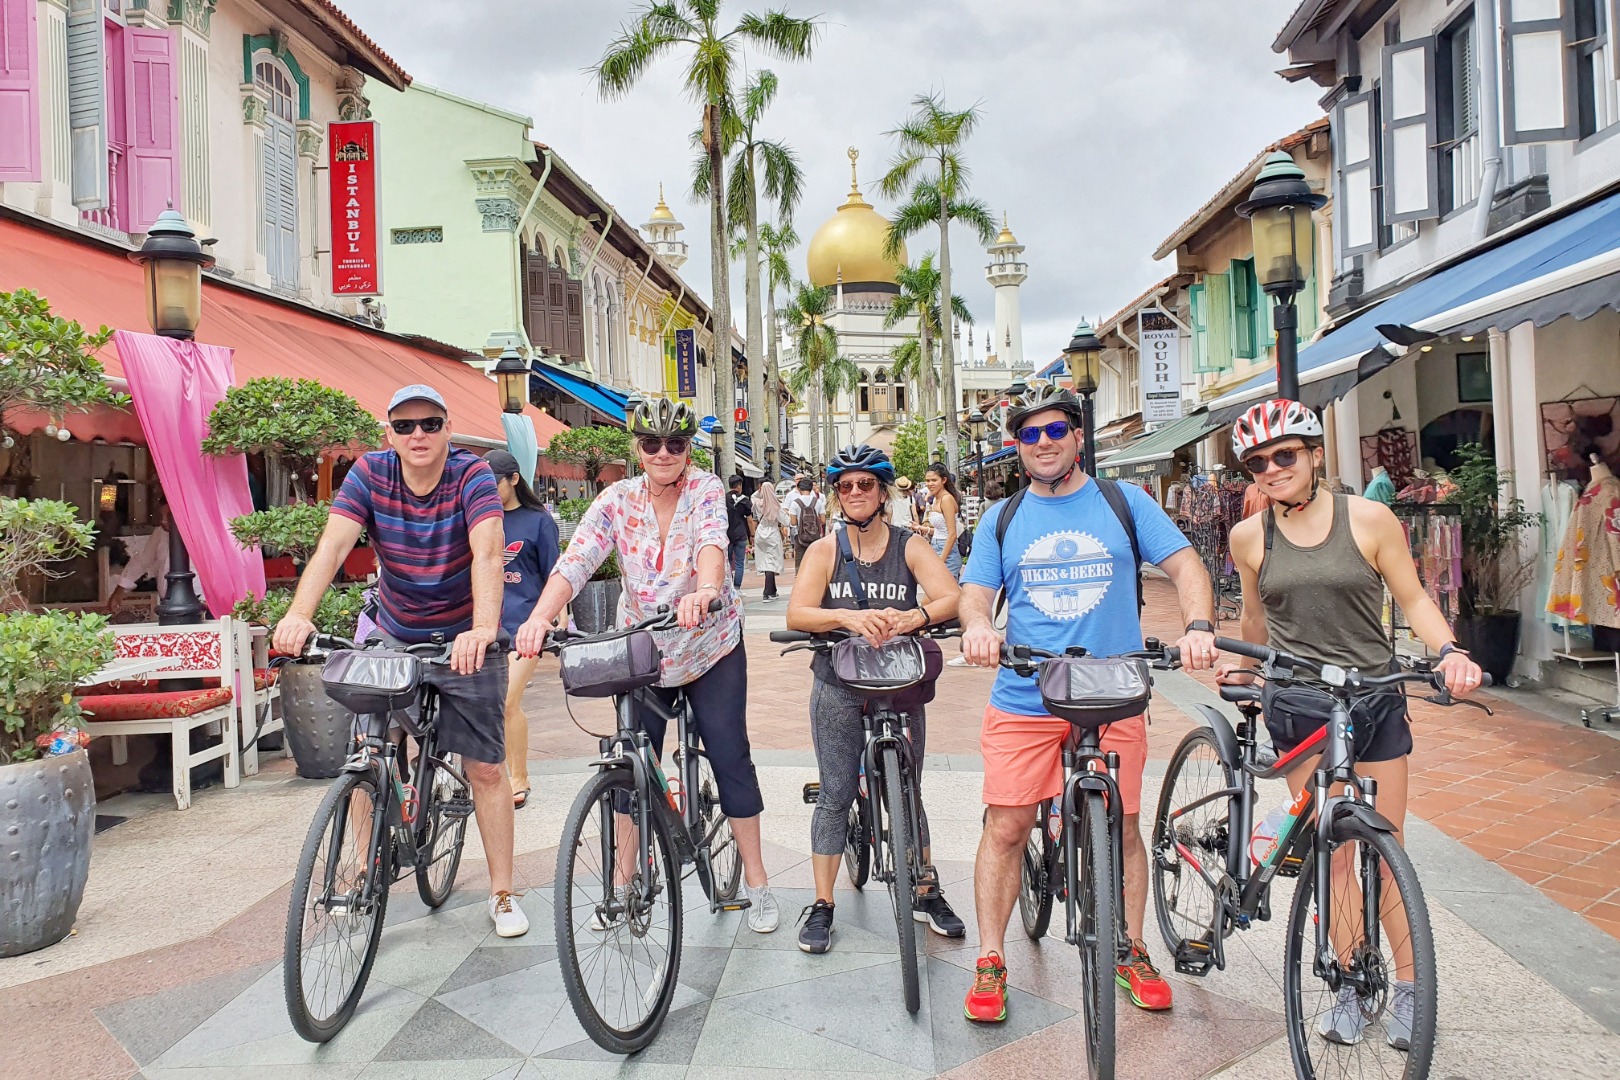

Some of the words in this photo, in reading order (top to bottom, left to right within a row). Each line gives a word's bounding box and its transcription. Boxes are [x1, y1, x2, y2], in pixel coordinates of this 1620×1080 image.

[345, 163, 360, 252] ISTANBUL
[1144, 332, 1177, 340] ROYAL
[682, 343, 690, 391] TURKISH
[1153, 340, 1169, 382] OUDH
[738, 410, 743, 419] i
[1059, 568, 1068, 579] &
[1069, 562, 1113, 580] BEERS
[829, 581, 907, 601] WARIOR
